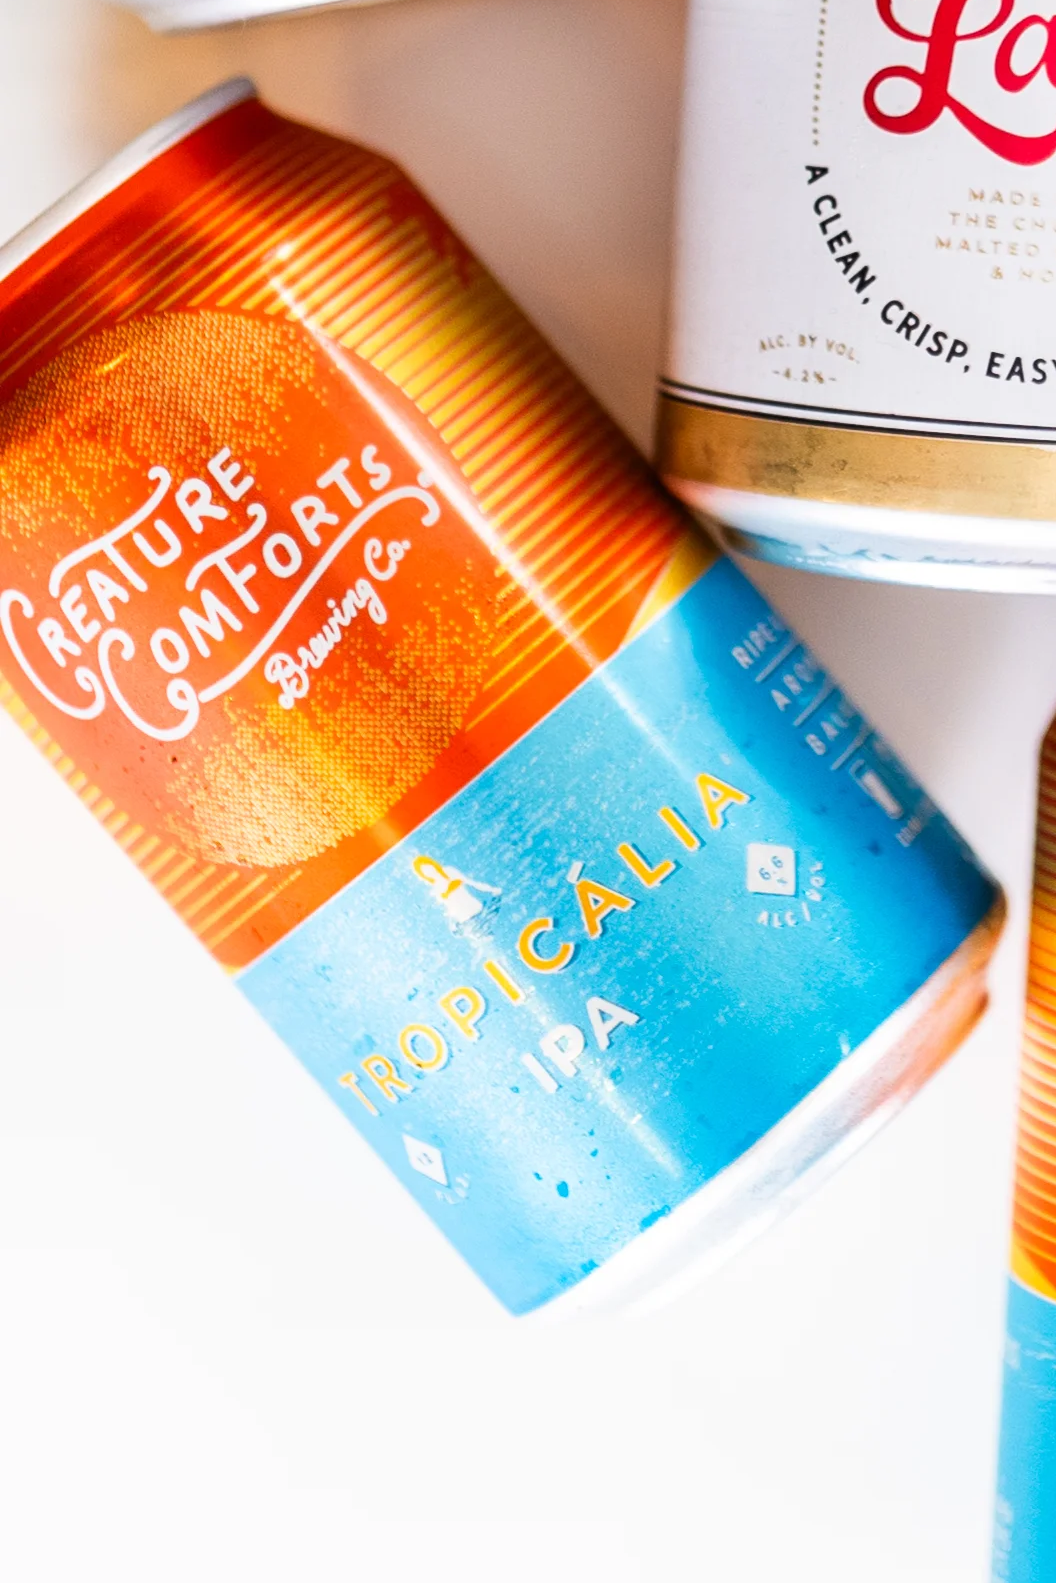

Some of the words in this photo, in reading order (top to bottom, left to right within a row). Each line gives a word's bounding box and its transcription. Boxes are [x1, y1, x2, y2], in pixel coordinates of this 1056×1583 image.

[804, 163, 830, 186] A
[949, 211, 998, 229] THE
[968, 188, 1041, 207] MADE
[813, 193, 877, 305] CLEAN,
[935, 235, 1040, 257] MALTED
[880, 298, 973, 374] CRISP,
[0, 447, 255, 720] CREATURE
[98, 443, 440, 742] COMFORTS
[263, 576, 388, 710] Brewing
[337, 771, 754, 1118] TROPICÁLIA
[521, 994, 643, 1096] IPA
